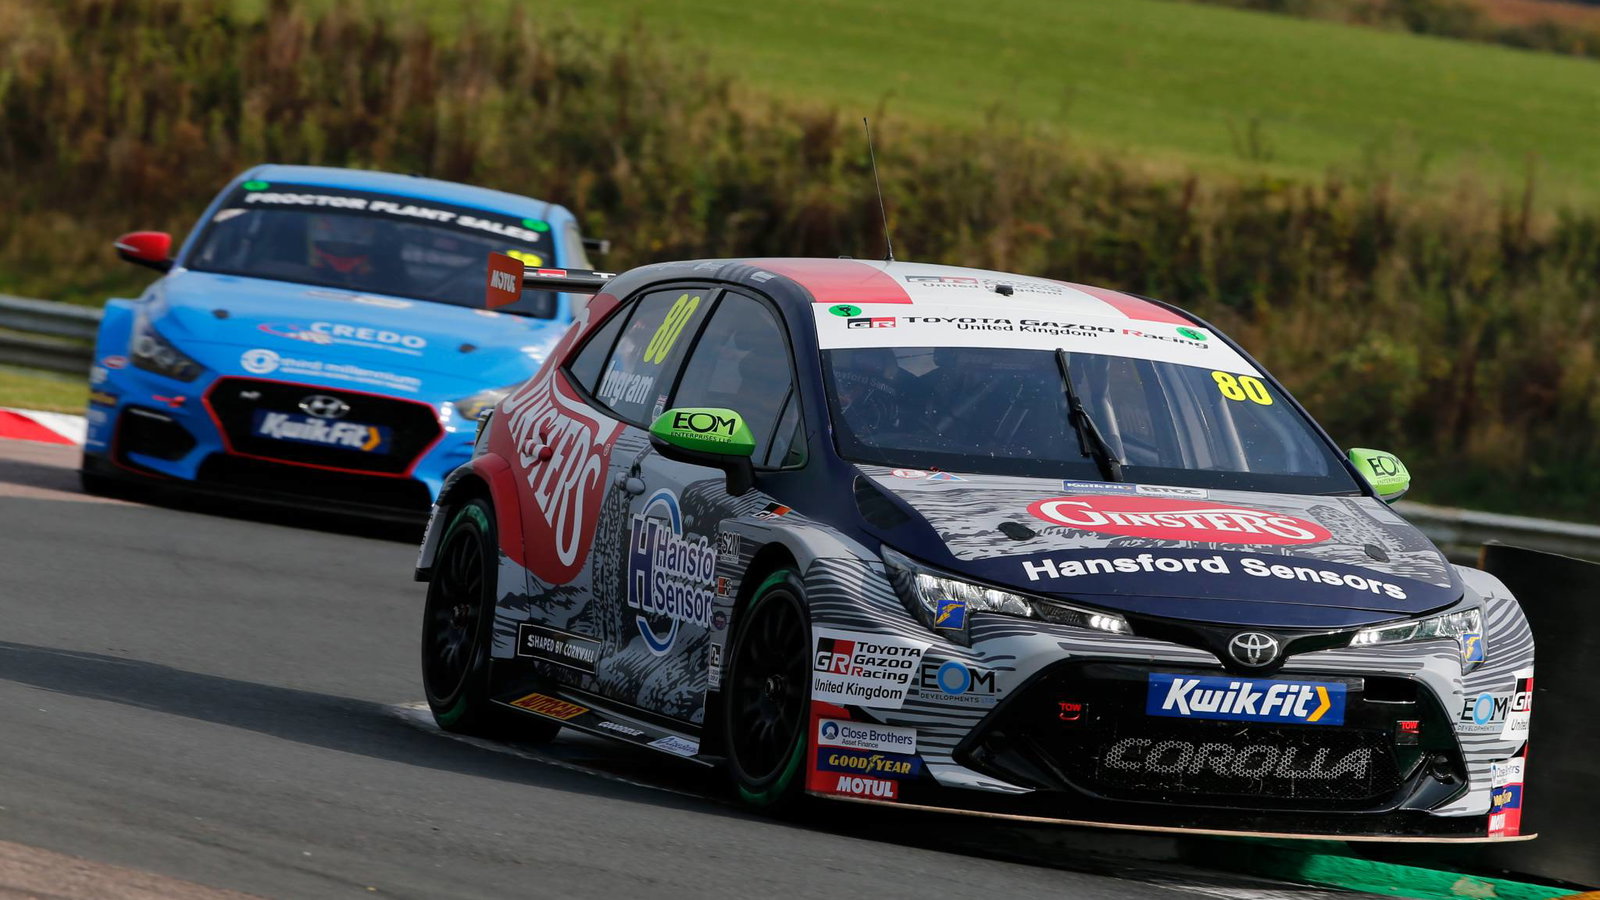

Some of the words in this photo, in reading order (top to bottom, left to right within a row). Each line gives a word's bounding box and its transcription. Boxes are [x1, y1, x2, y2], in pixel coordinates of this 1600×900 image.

[245, 192, 367, 209] PROCTOR
[369, 201, 456, 222] PLANT
[456, 215, 540, 242] SALES
[490, 269, 517, 293] MOTUL
[309, 321, 428, 349] CREDO
[643, 293, 701, 365] 80
[848, 318, 896, 330] GR
[902, 316, 1012, 325] TOYOTA
[1019, 319, 1115, 333] GAZOO
[1122, 328, 1209, 349] Racing
[957, 323, 1014, 333] United
[1019, 325, 1098, 339] Kingdom
[599, 360, 654, 407] Ingram
[1210, 370, 1274, 406] 80
[672, 411, 736, 436] EOM
[670, 430, 718, 442] ENTERPRISES
[1039, 499, 1317, 541] GINSTERS
[655, 524, 717, 587] Hansfo
[1021, 553, 1231, 582] Hansford
[1239, 557, 1408, 601] Sensors
[527, 633, 555, 650] SHAPED
[555, 640, 564, 654] BY
[564, 643, 596, 664] CORNWALL
[857, 641, 922, 657] TOYOTA
[814, 650, 851, 676] GR
[853, 654, 913, 669] GAZOO
[850, 666, 909, 684] Racing
[921, 661, 996, 695] EOM
[814, 678, 844, 694] United
[845, 682, 903, 701] Kingdom
[919, 692, 980, 704] DEVELOPMENTS
[1059, 702, 1082, 712] TOW
[1460, 693, 1509, 726] EOM
[841, 726, 868, 740] Close
[869, 729, 913, 746] Brothers
[1399, 720, 1419, 730] TOW
[841, 738, 856, 746] Asset
[856, 740, 879, 749] Finance
[828, 753, 912, 775] GOODYEAR
[1103, 737, 1372, 780] COROLLA
[836, 775, 894, 798] MOTUL
